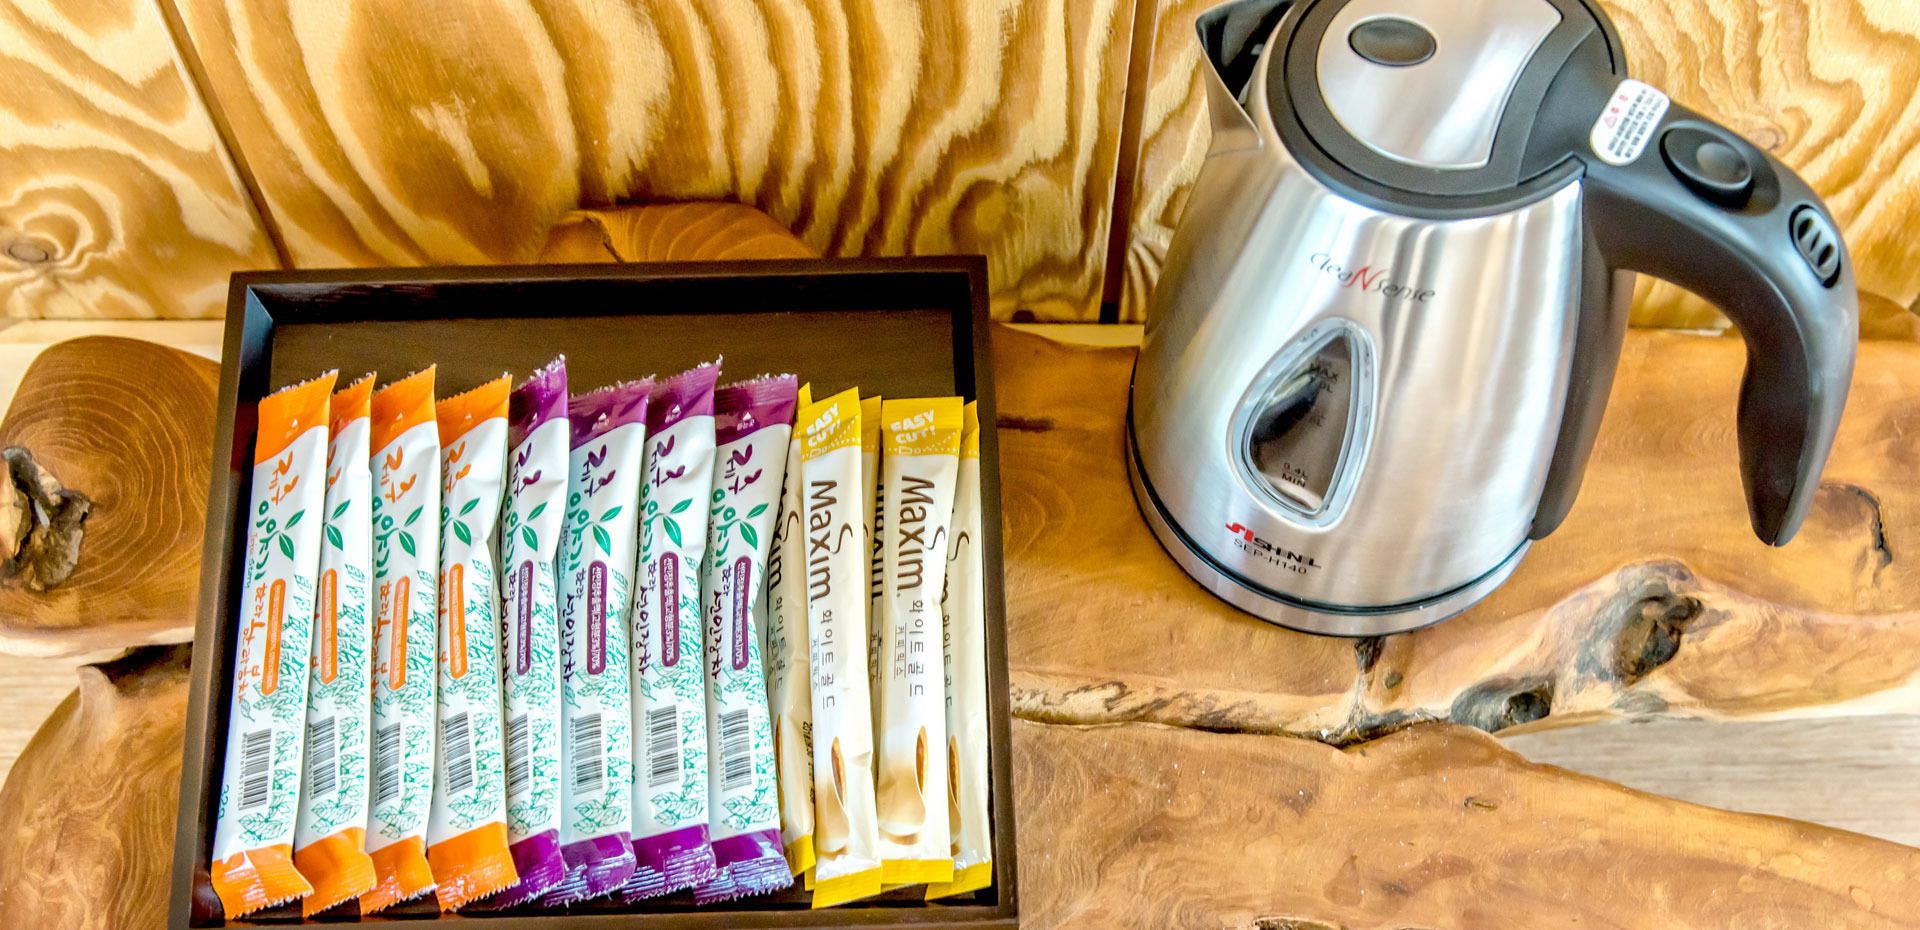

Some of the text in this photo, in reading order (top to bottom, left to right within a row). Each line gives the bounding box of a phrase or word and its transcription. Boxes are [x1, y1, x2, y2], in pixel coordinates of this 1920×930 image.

[806, 402, 839, 436] EASY
[890, 409, 935, 432] EASY
[808, 418, 841, 447] CUT!
[895, 425, 935, 444] CUT!
[1281, 472, 1306, 488] MIN
[1234, 538, 1307, 574] SEP-H140
